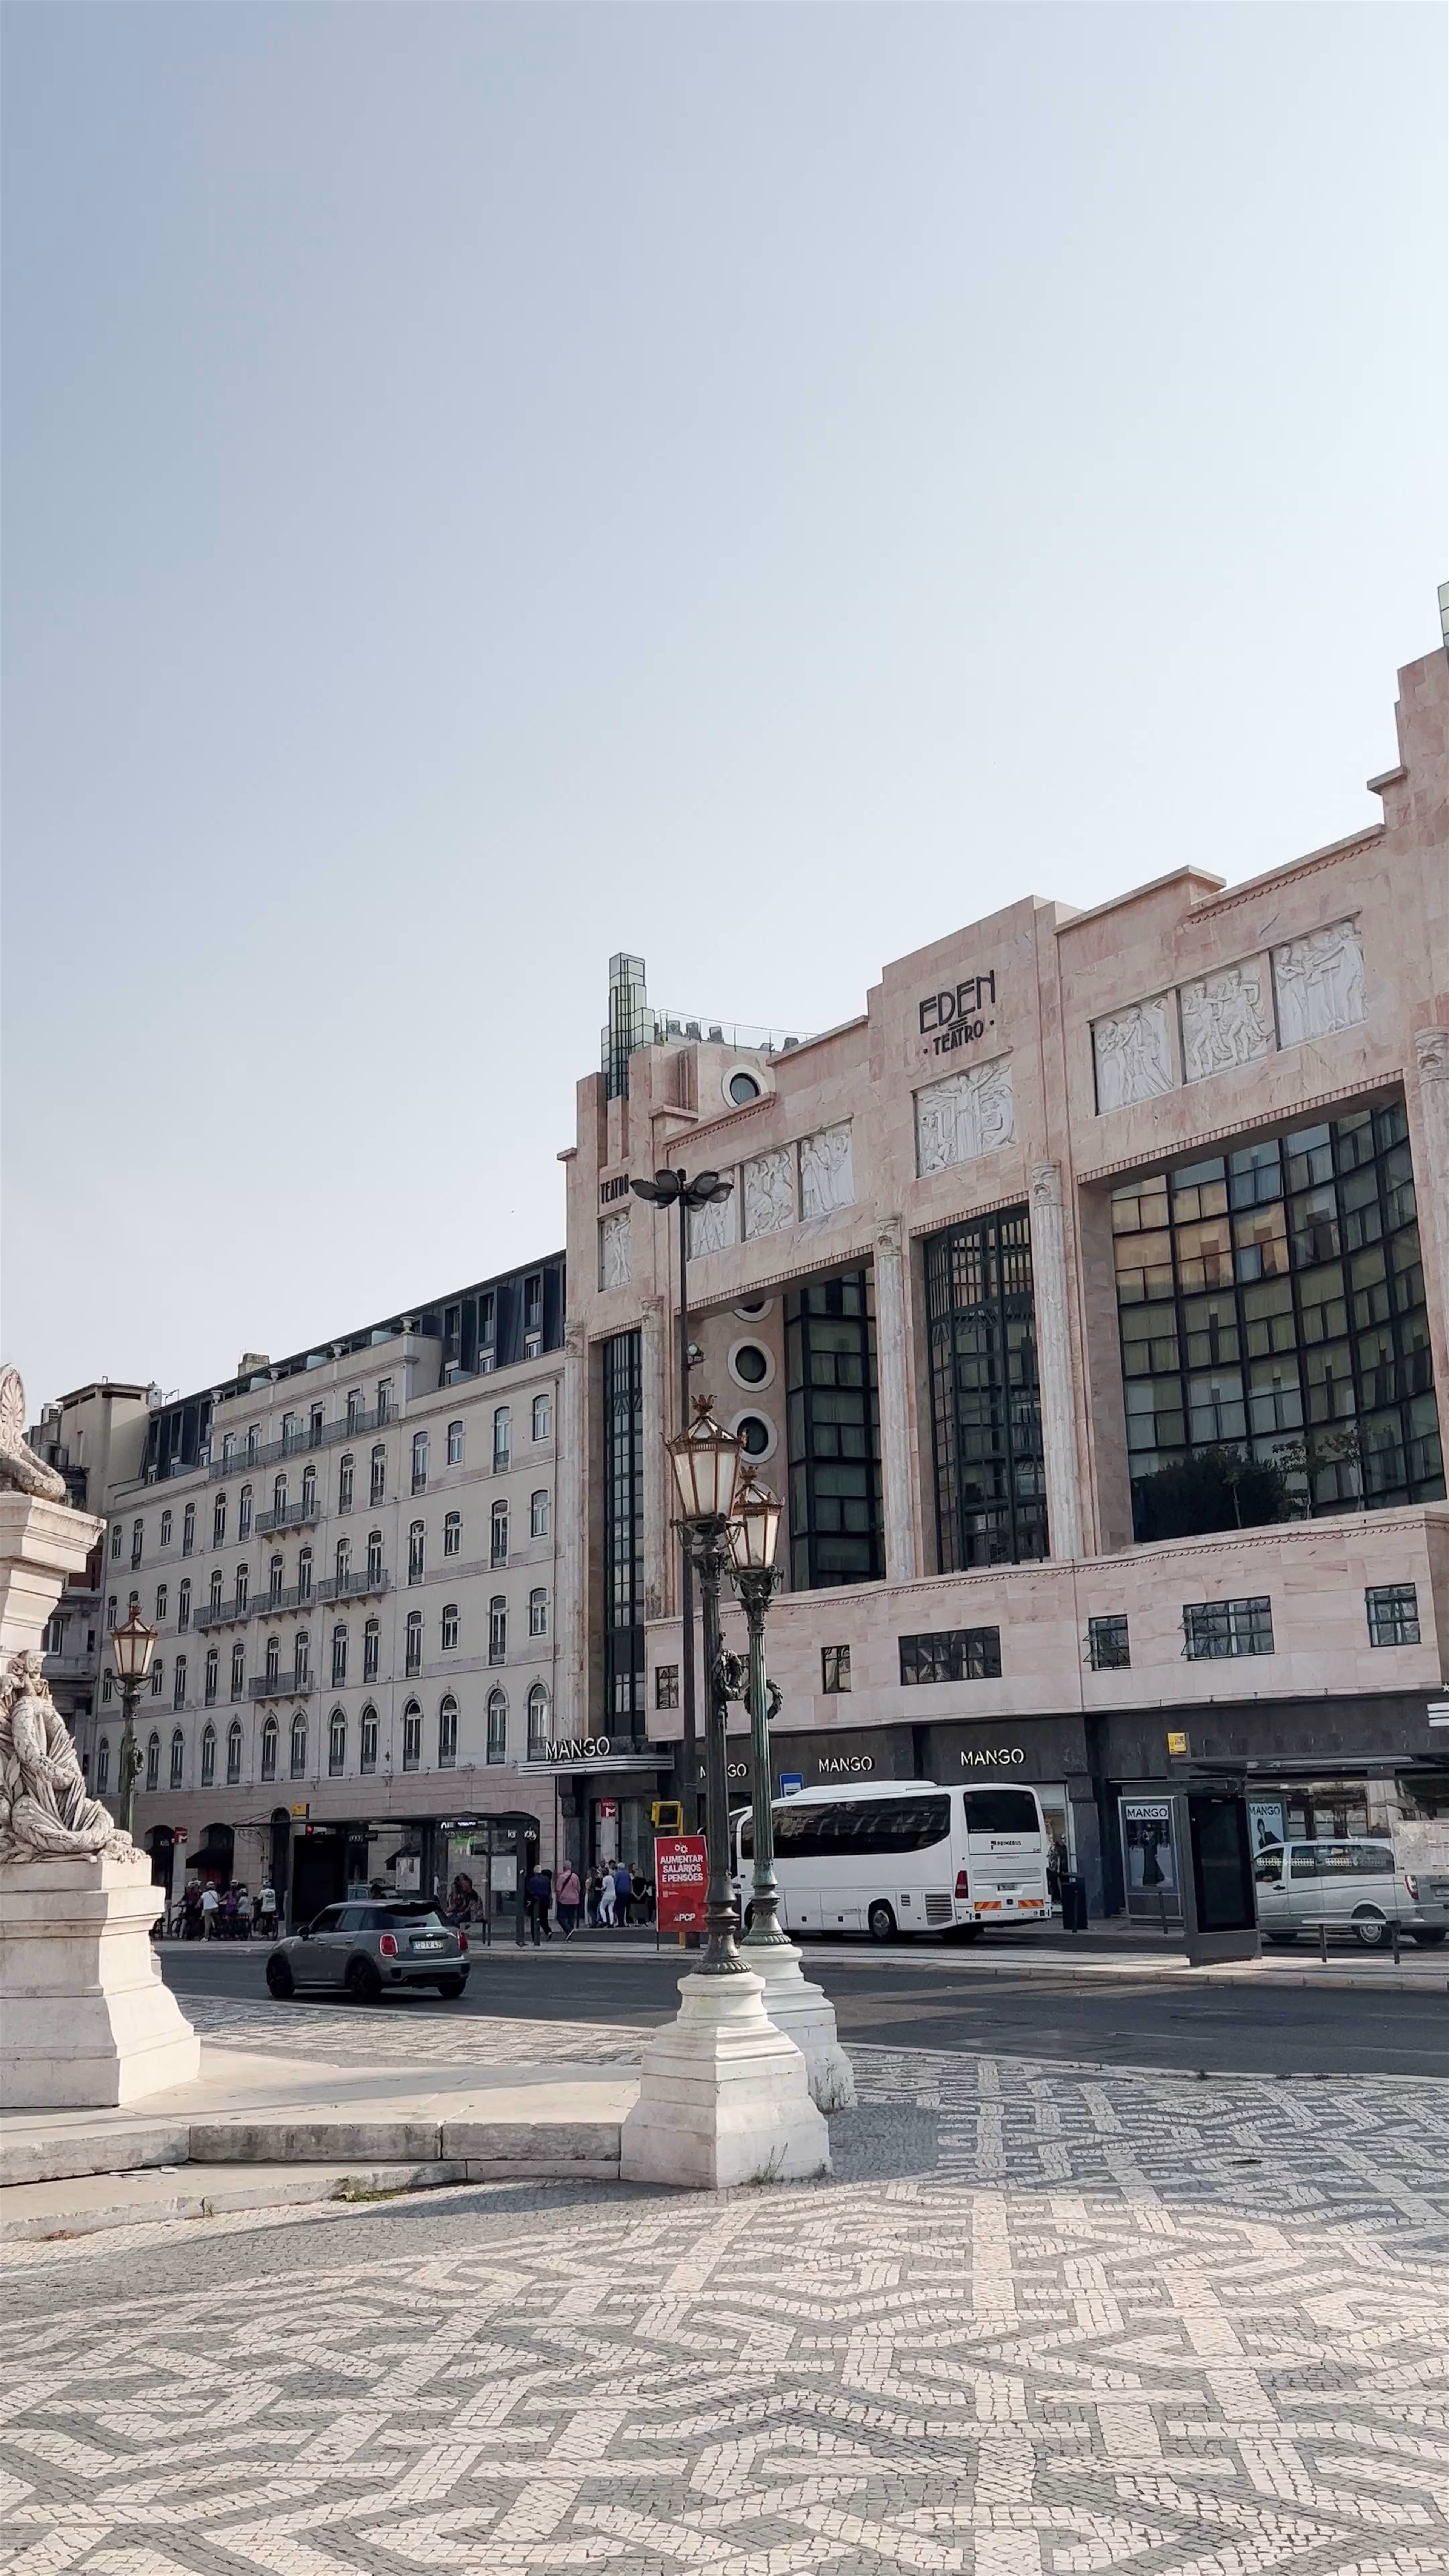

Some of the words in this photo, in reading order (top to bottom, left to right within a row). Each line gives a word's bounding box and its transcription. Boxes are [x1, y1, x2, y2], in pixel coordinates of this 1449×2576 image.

[920, 970, 995, 1034] EDEN
[600, 1173, 629, 1204] TEATRO
[546, 1736, 610, 1760] MANGO
[818, 1756, 872, 1773] MANGO
[960, 1749, 1024, 1766] MANGO
[1127, 1808, 1167, 1817] MANGO
[1249, 1806, 1280, 1815] MANGO
[660, 1855, 703, 1864] AUMENTAR
